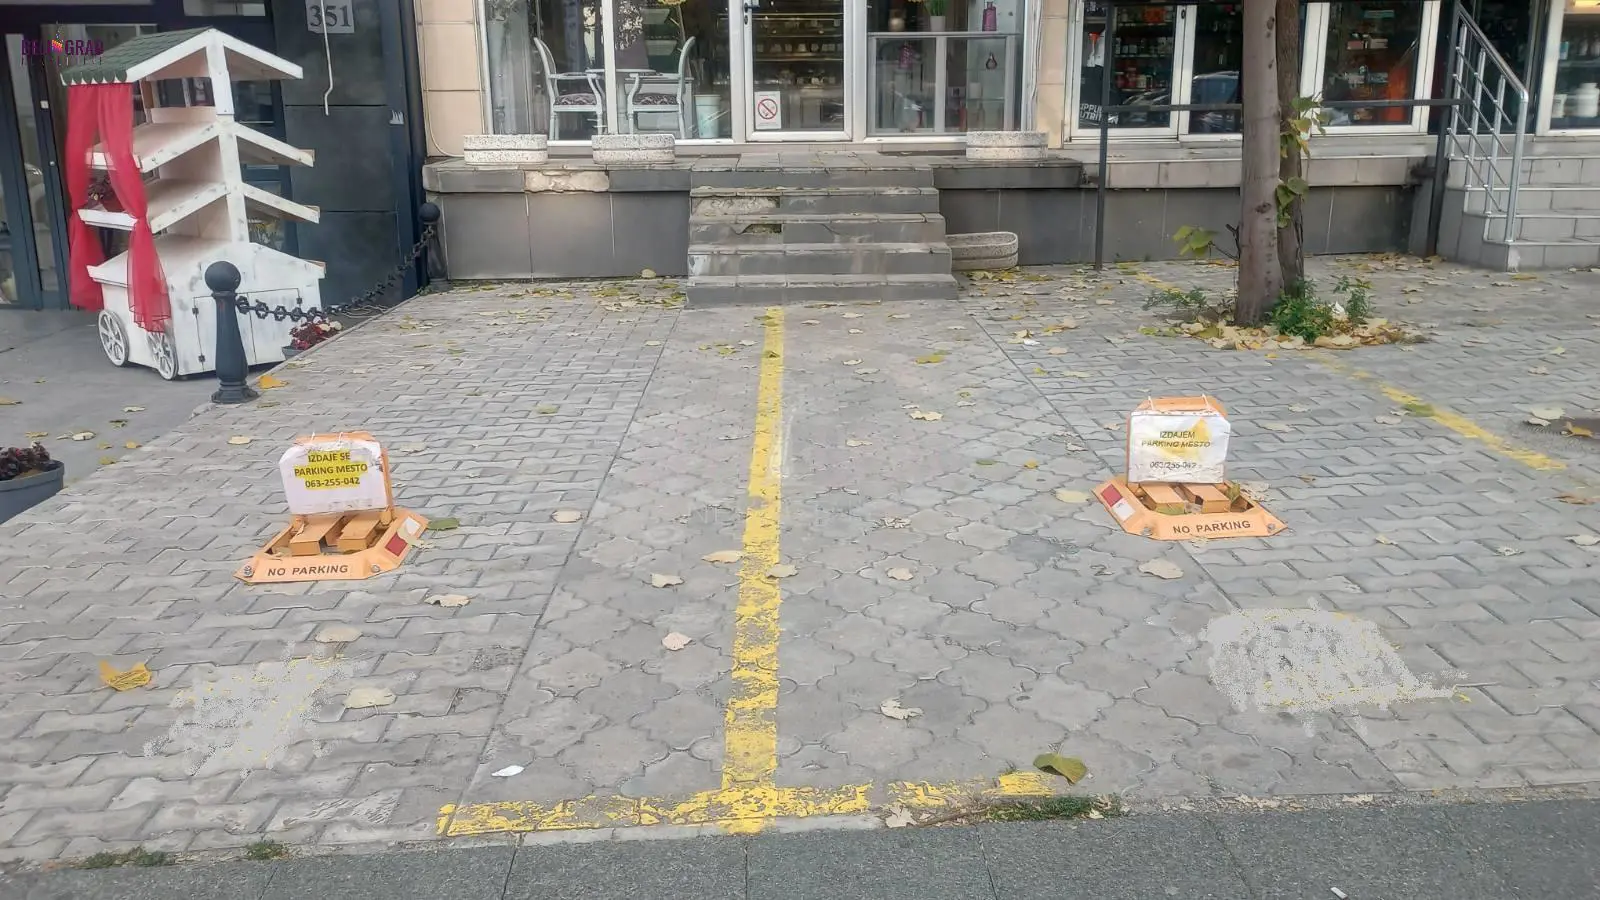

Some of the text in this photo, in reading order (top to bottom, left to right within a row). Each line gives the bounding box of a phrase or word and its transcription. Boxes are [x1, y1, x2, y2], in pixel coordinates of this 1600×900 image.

[309, 5, 352, 27] 351
[1159, 430, 1196, 439] IZDAJEM
[1141, 439, 1211, 448] PARKING MESTO
[307, 452, 351, 463] IZDAJE SE
[294, 463, 368, 477] PARKING MESTO
[304, 476, 361, 488] 063-255-042
[1172, 520, 1251, 534] NO PARKING
[267, 564, 349, 577] NO PARKING
